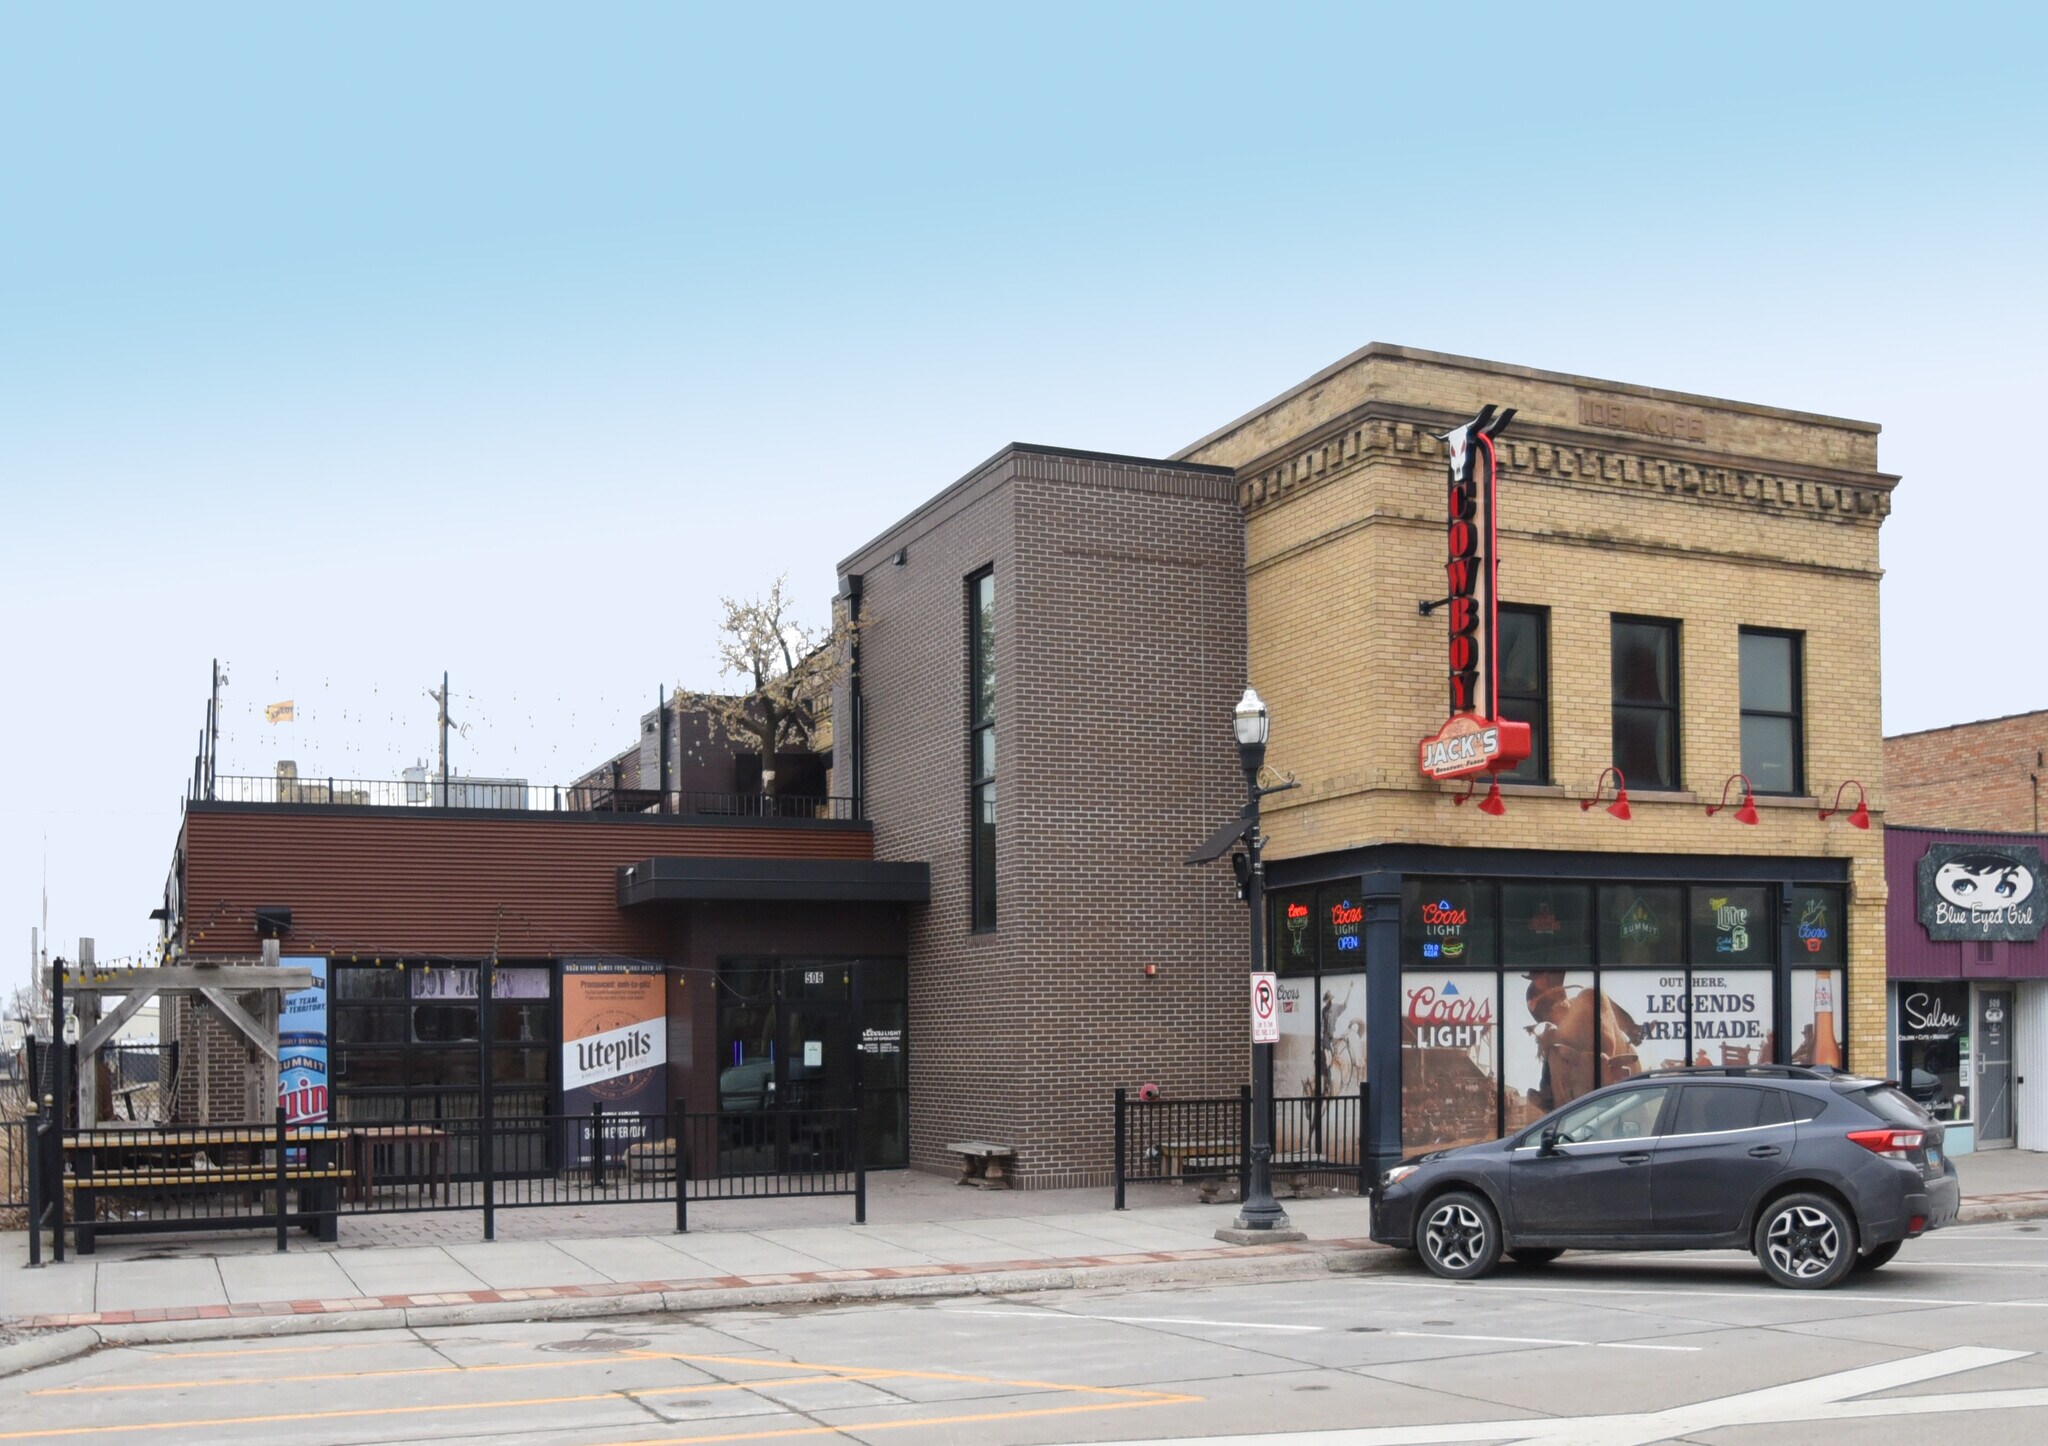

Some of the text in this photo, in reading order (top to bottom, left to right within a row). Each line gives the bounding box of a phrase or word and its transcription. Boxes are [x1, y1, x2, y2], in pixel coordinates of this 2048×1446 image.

[1445, 481, 1481, 711] COWBOY
[1423, 728, 1498, 768] JACK'S
[1287, 903, 1309, 918] Coors
[1331, 903, 1364, 925] Coors
[1421, 903, 1467, 925] Coors
[1716, 906, 1747, 931] Lite
[1936, 901, 2033, 933] Blue Eyed Girl
[1334, 923, 1358, 936] LIGHT
[1426, 924, 1461, 936] LIGHT
[1623, 922, 1657, 935] SUMMIT
[1797, 923, 1828, 939] Coors
[412, 969, 446, 997] BOY
[804, 971, 824, 984] 506
[1659, 977, 1727, 989] OUT HERE,
[1275, 983, 1299, 1000] Coors
[1406, 986, 1493, 1025] Coors
[1905, 992, 1961, 1029] Salon
[1417, 1025, 1484, 1049] LIGHT
[1640, 1020, 1765, 1041] ARE MADE.
[577, 1030, 651, 1072] Utepils
